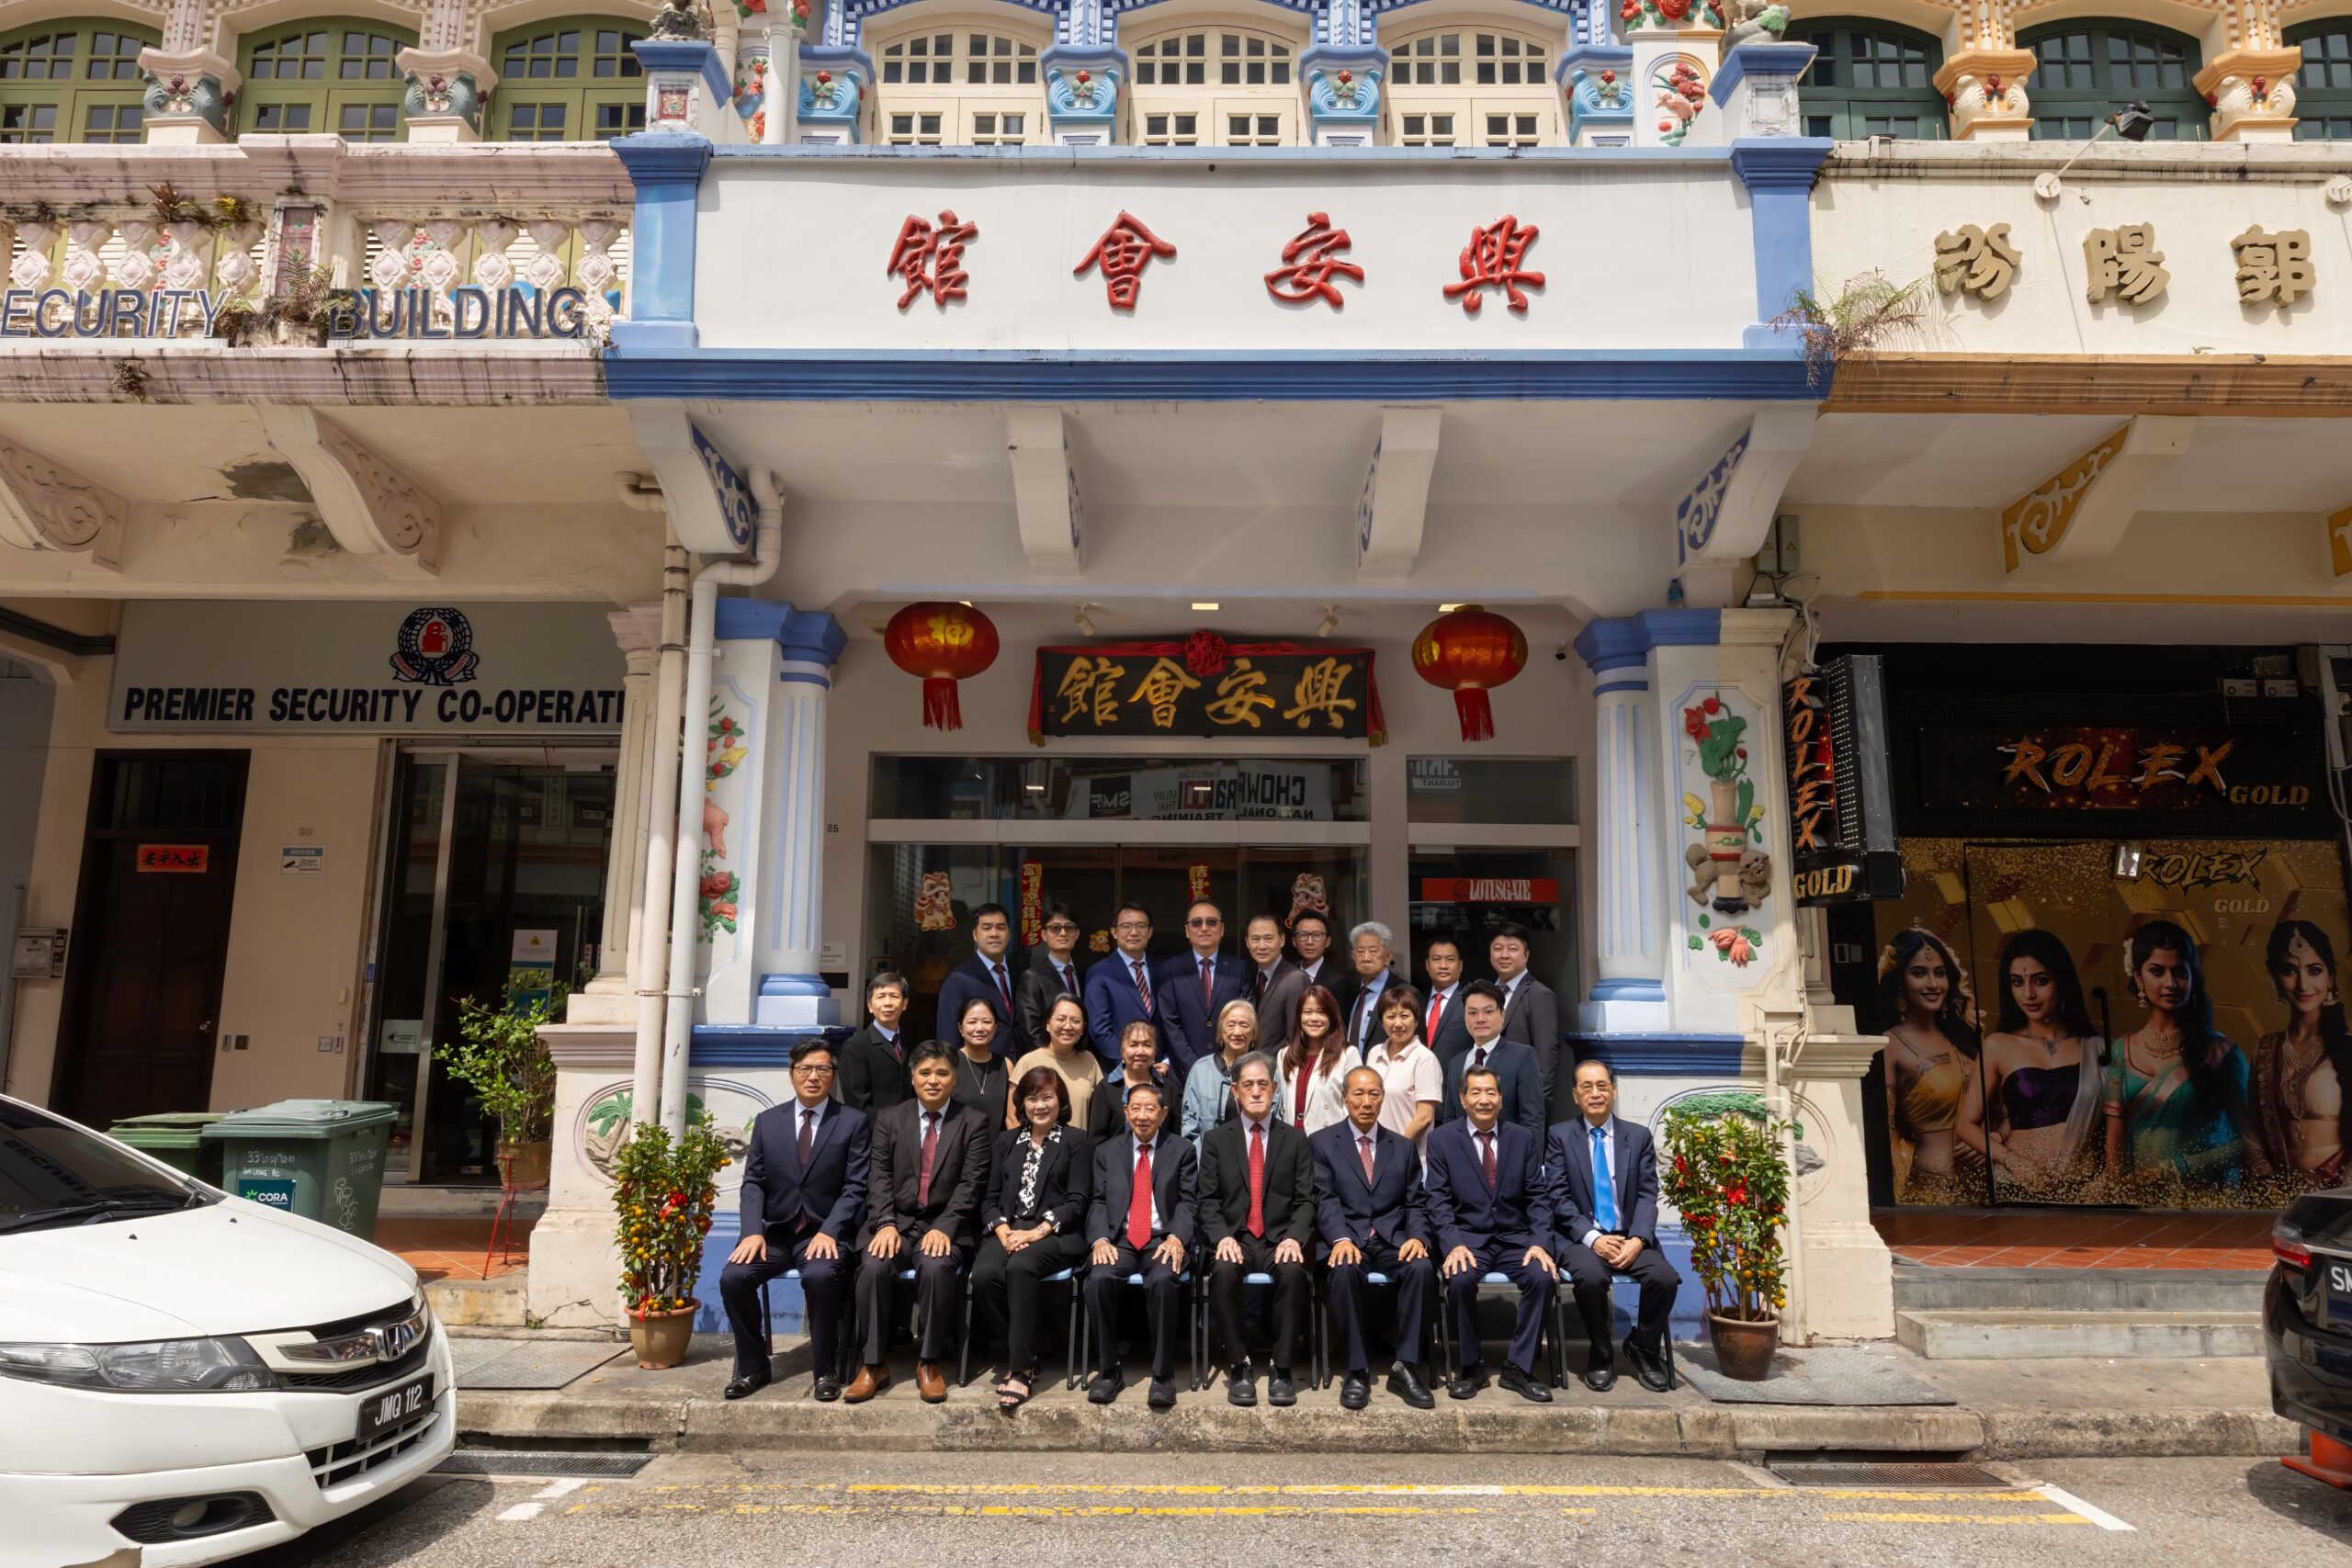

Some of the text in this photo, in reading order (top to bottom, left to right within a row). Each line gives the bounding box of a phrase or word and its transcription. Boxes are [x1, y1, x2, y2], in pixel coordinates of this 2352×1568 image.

[1, 287, 589, 340] ECURITY BUILDING
[124, 687, 255, 721] PREMIER
[269, 688, 423, 723] SECURITY
[1786, 675, 1818, 852] ROLEX
[2000, 737, 2310, 806] ROLEX GOLD
[1794, 863, 1852, 898] GOLD
[2141, 848, 2265, 890] ROLEX
[1469, 879, 1532, 901] LOTUSGATE
[2213, 897, 2269, 915] GOLD
[258, 1192, 288, 1201] CORA
[374, 1383, 423, 1426] JMQ 112
